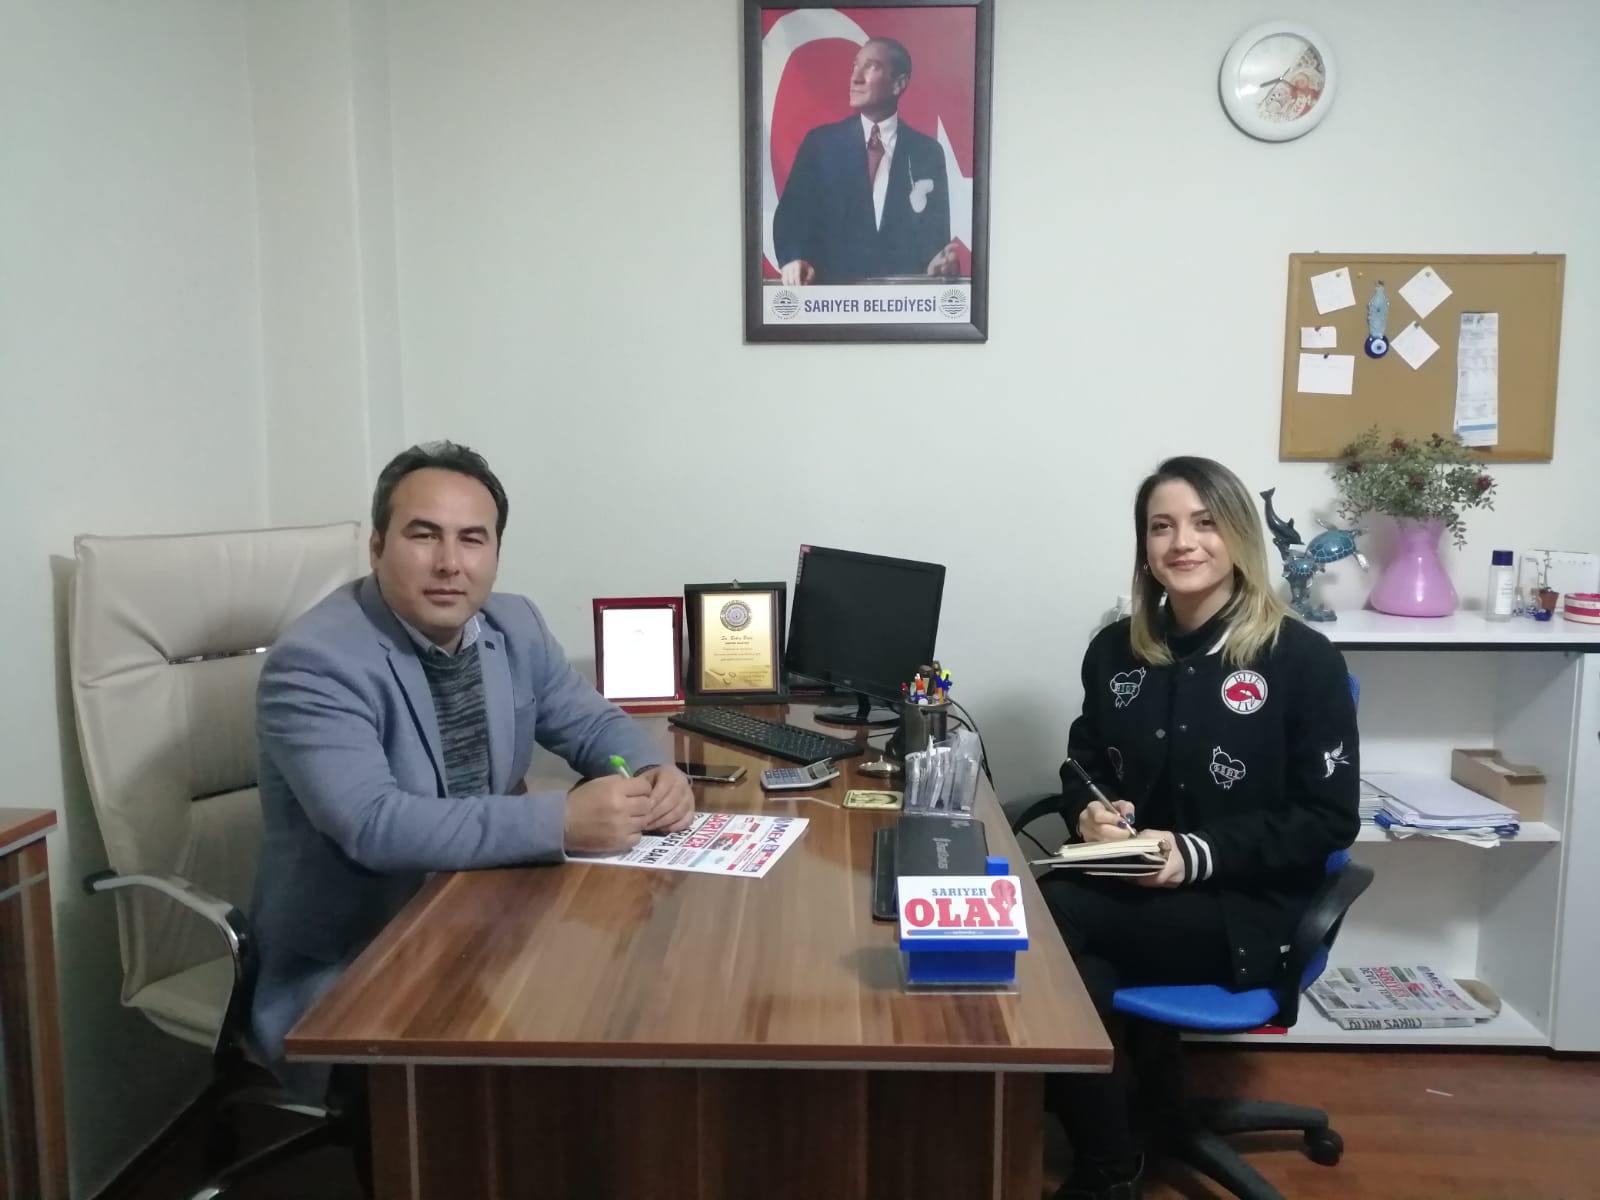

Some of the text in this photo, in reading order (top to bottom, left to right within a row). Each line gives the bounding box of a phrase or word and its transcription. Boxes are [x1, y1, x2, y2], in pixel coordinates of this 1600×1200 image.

[804, 296, 936, 313] SARIYER BELEDİYESİ
[931, 887, 987, 897] SARIYER
[905, 898, 1017, 927] OLAY
